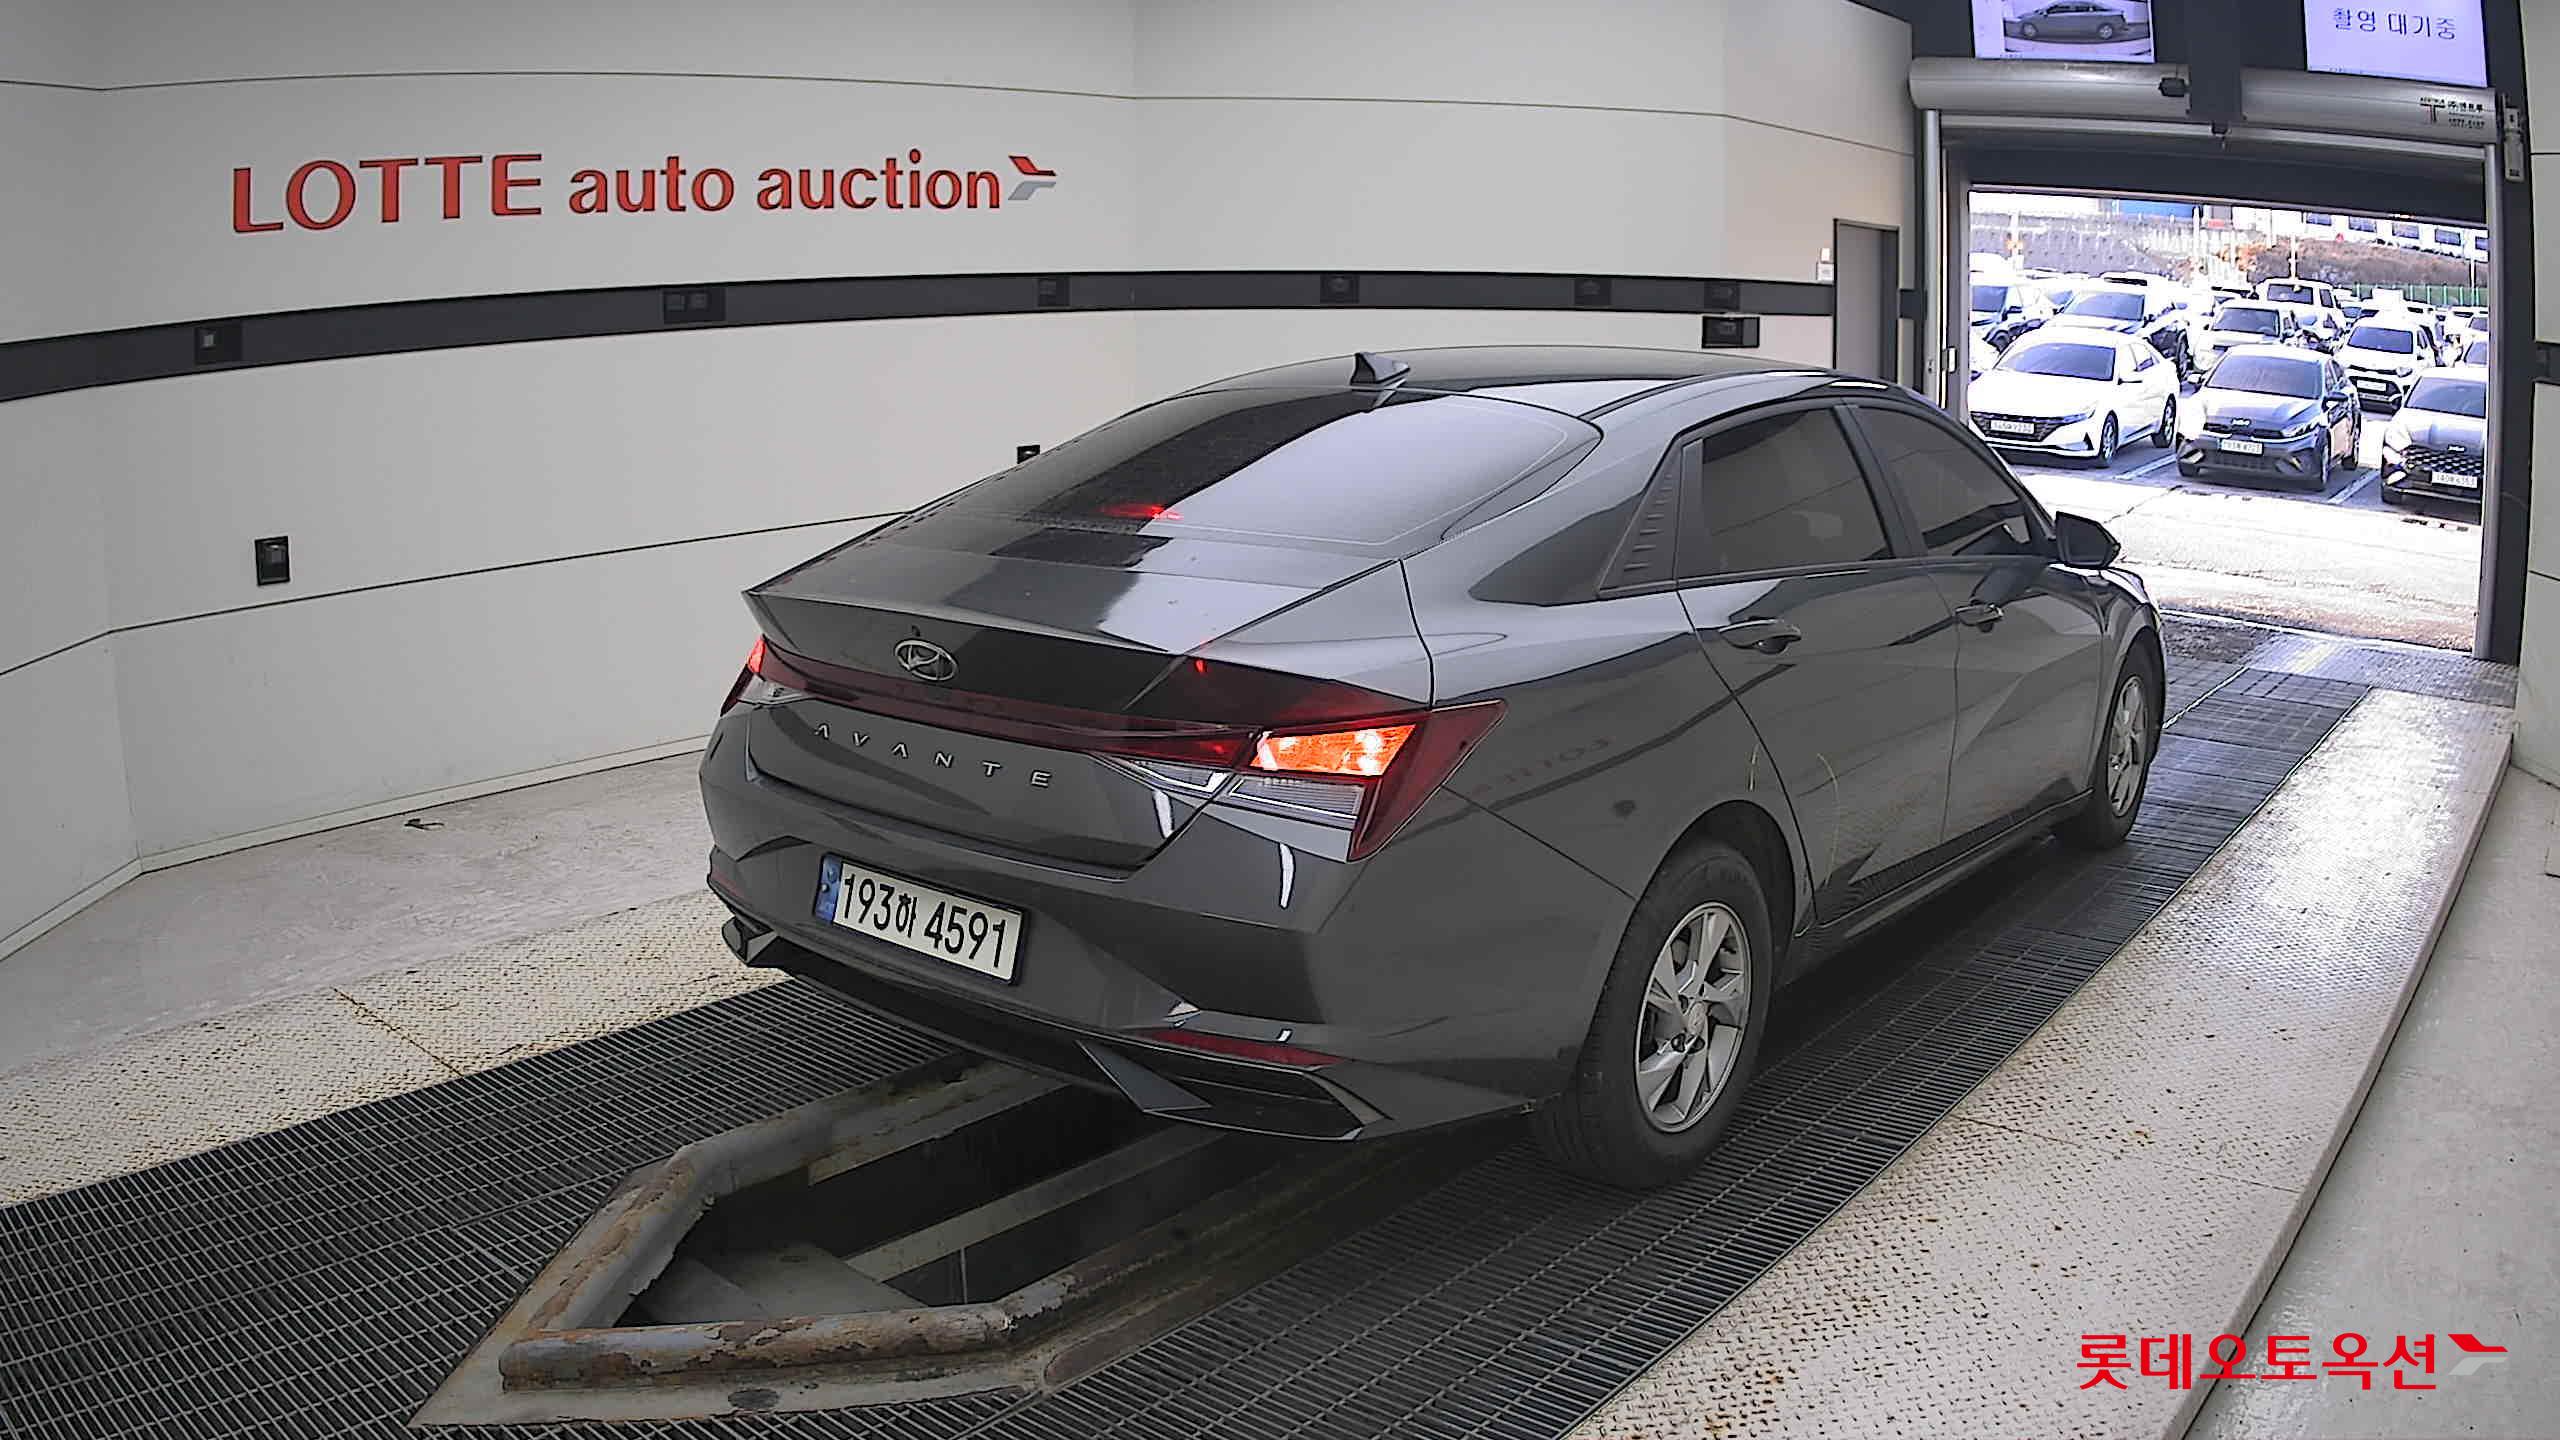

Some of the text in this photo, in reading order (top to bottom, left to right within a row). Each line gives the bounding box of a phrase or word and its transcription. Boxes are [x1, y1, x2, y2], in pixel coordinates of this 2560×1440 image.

[2388, 12, 2456, 40] 대기중
[233, 148, 1001, 234] LOTTE auto auction
[815, 724, 1051, 787] AVANTE
[844, 873, 1006, 968] 193하 4591
